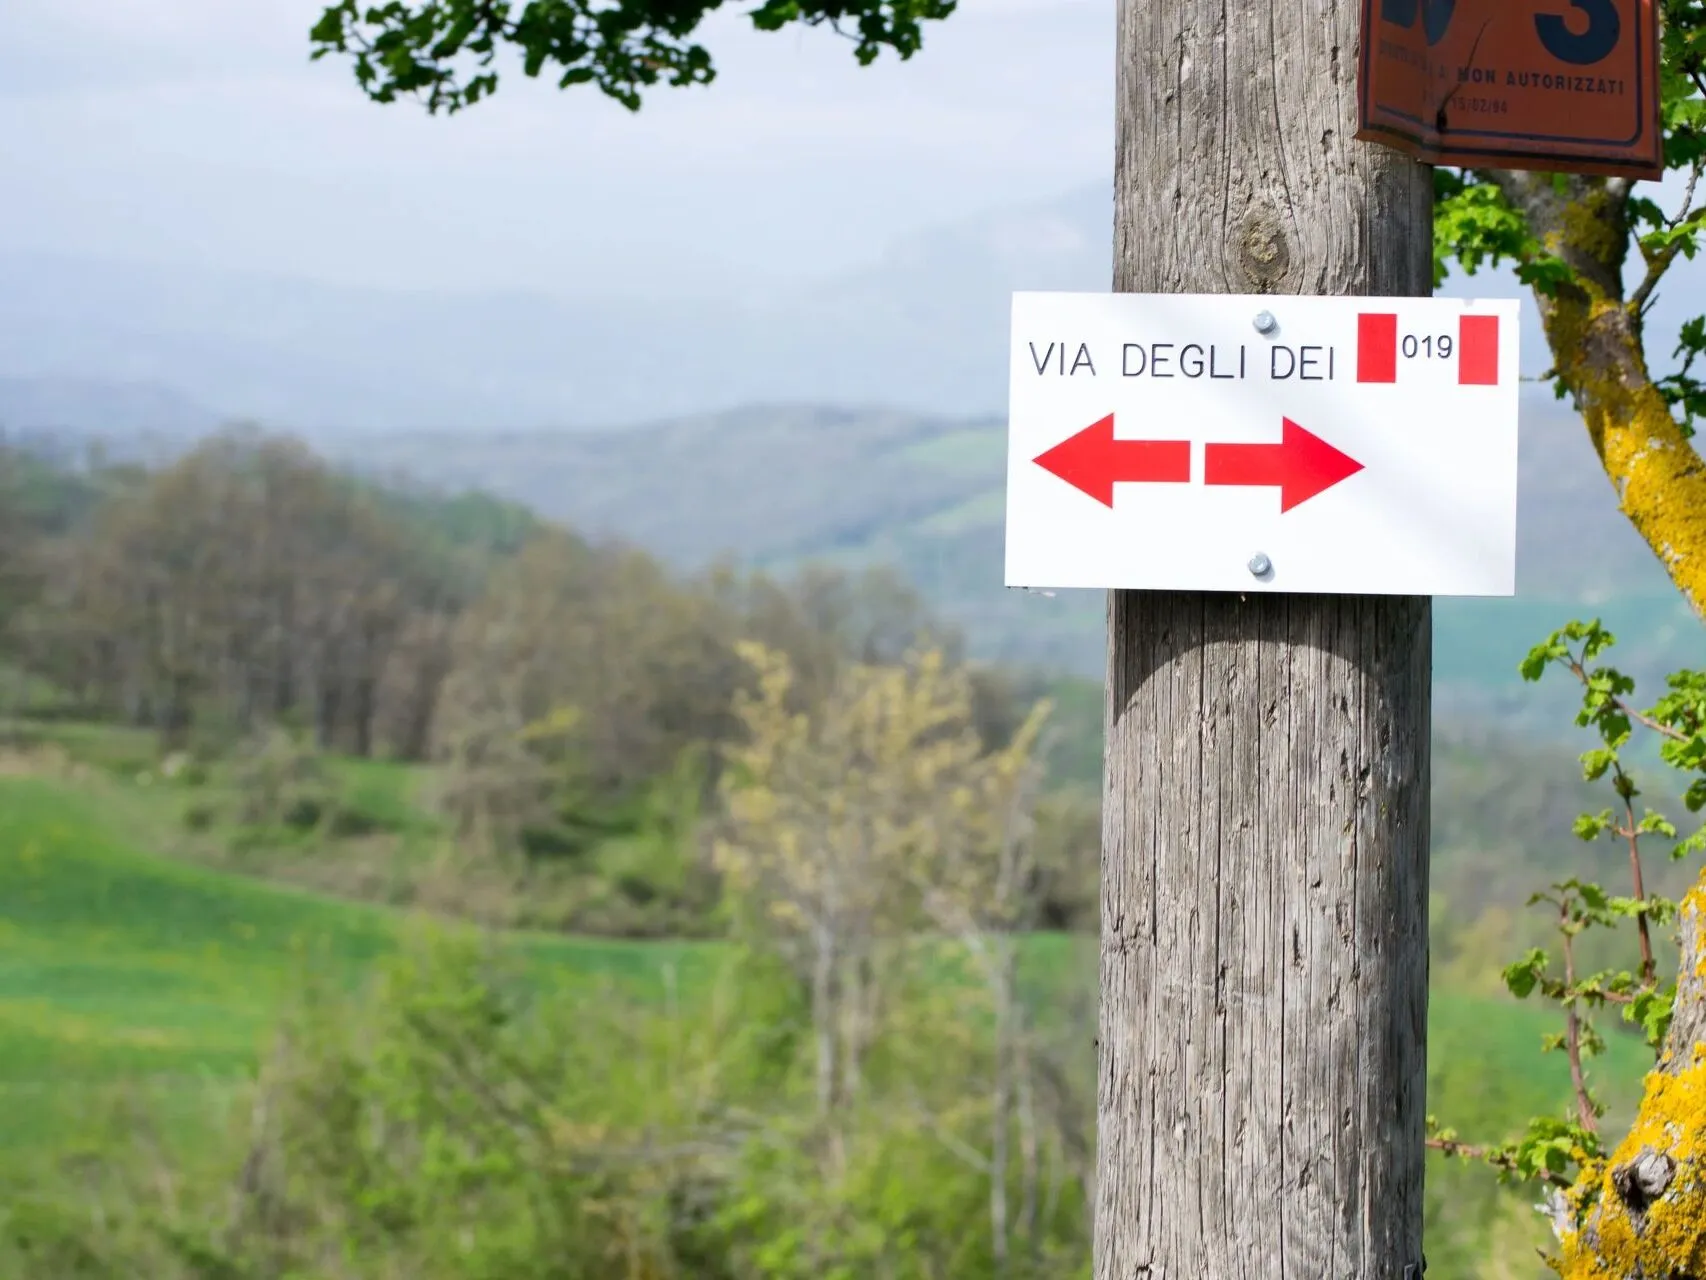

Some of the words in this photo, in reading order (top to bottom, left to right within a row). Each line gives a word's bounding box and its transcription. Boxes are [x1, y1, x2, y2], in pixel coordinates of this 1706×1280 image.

[1456, 67, 1496, 84] NON
[1506, 71, 1625, 96] AUTORIZZATI
[1029, 342, 1096, 377] VIA
[1122, 344, 1246, 380] DEGLI
[1271, 346, 1335, 381] DEI
[1402, 335, 1454, 359] 019
